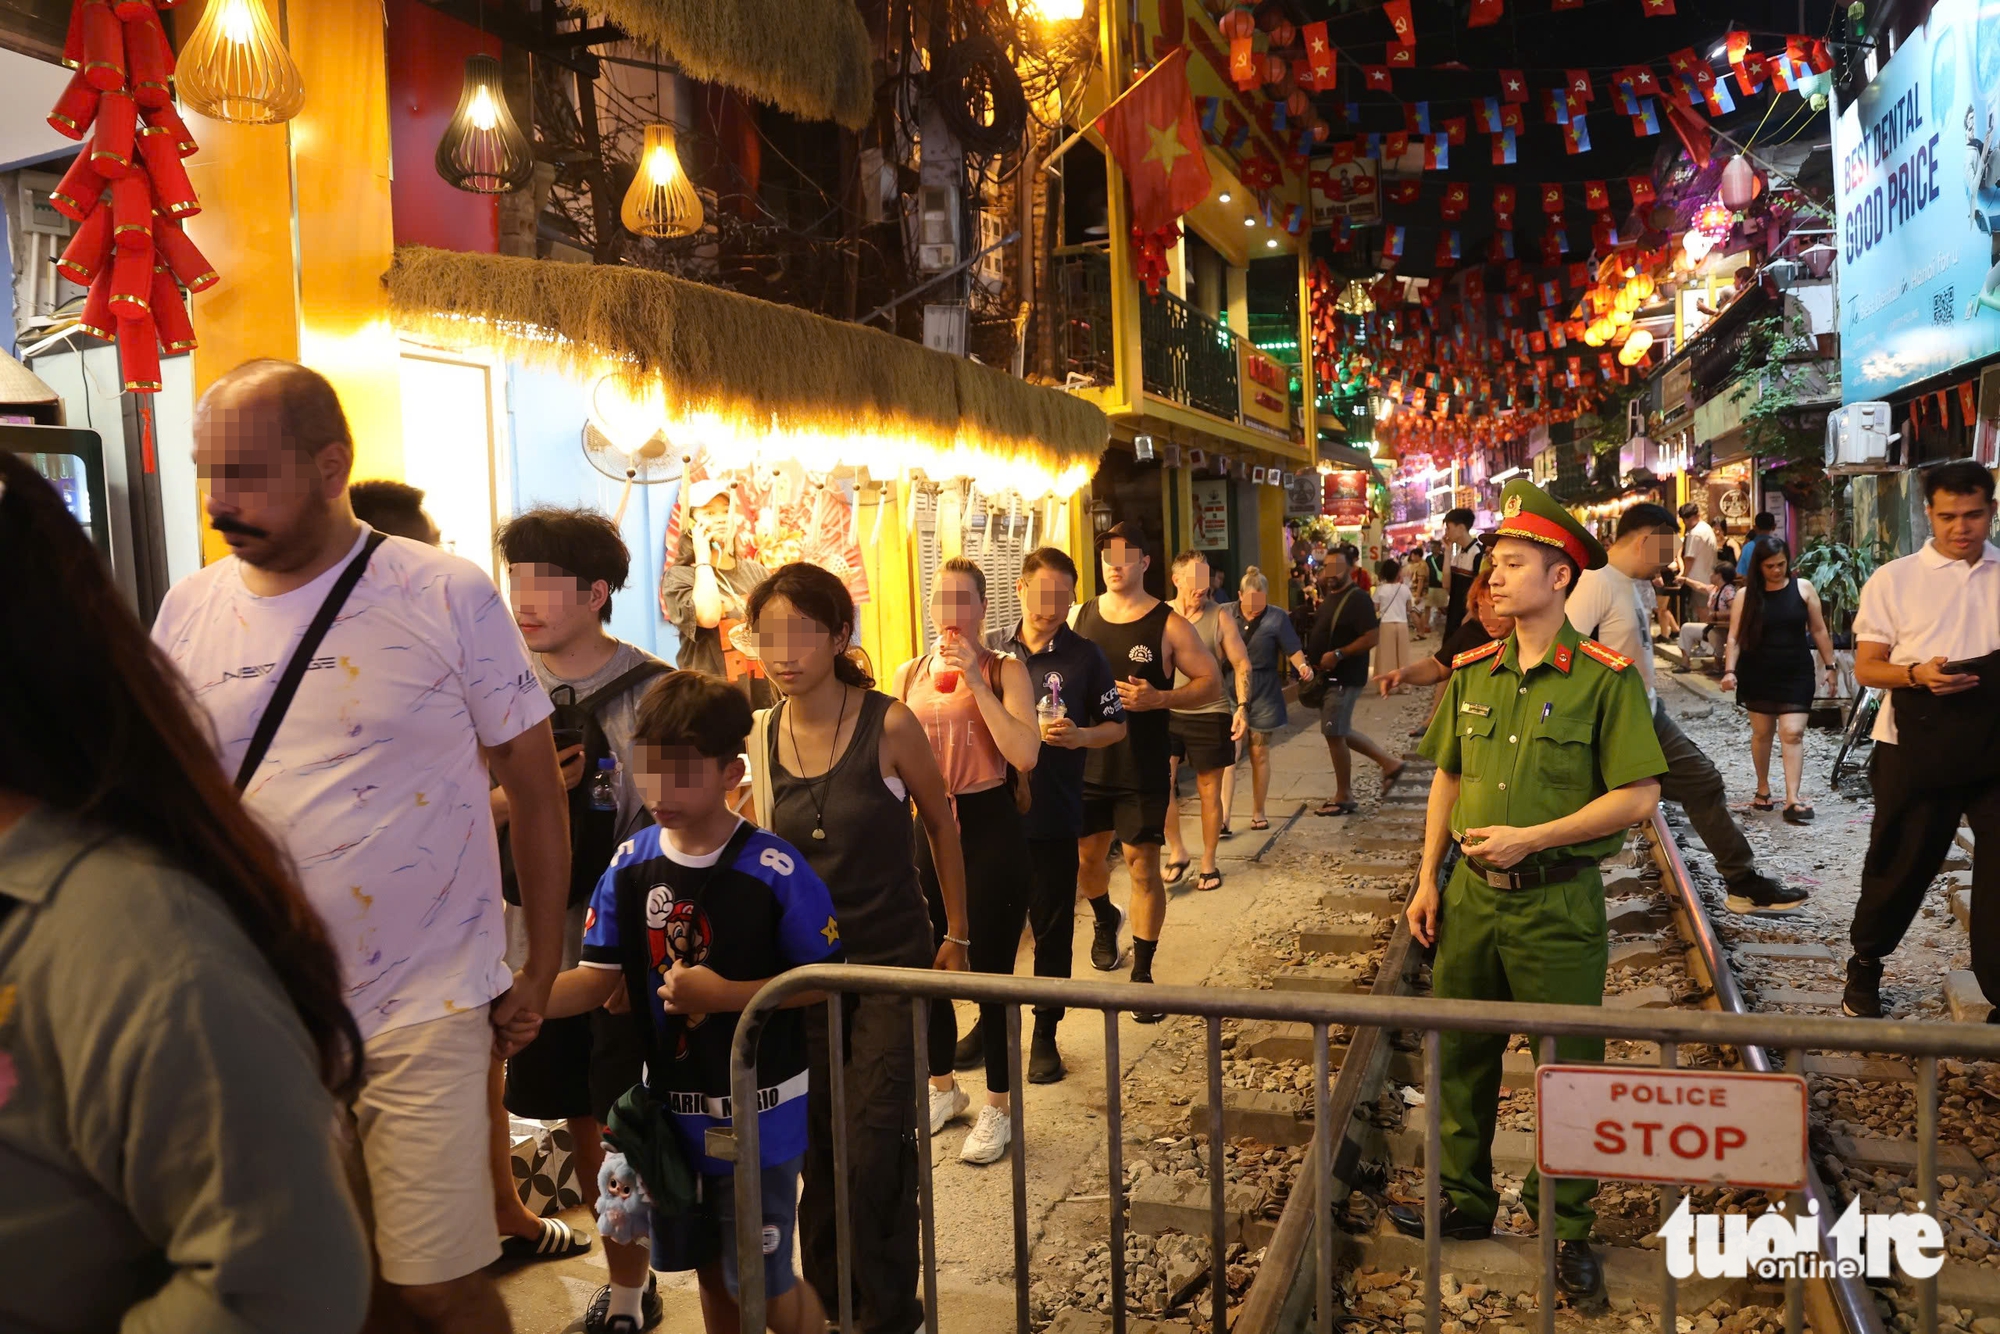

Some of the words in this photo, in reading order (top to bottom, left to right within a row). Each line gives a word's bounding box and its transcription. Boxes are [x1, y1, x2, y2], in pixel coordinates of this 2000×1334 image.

[1845, 131, 1870, 195] BEST
[1874, 82, 1923, 167] DENTAL
[1845, 185, 1883, 265] GOOD
[1888, 132, 1940, 234] PRICE
[1900, 277, 1909, 296] in
[1911, 257, 1936, 291] Hanoi
[1937, 250, 1951, 276] for
[759, 847, 796, 877] 8
[669, 1092, 710, 1114] ARIO
[1610, 1082, 1727, 1107] POLICE
[1593, 1120, 1748, 1161] STOP
